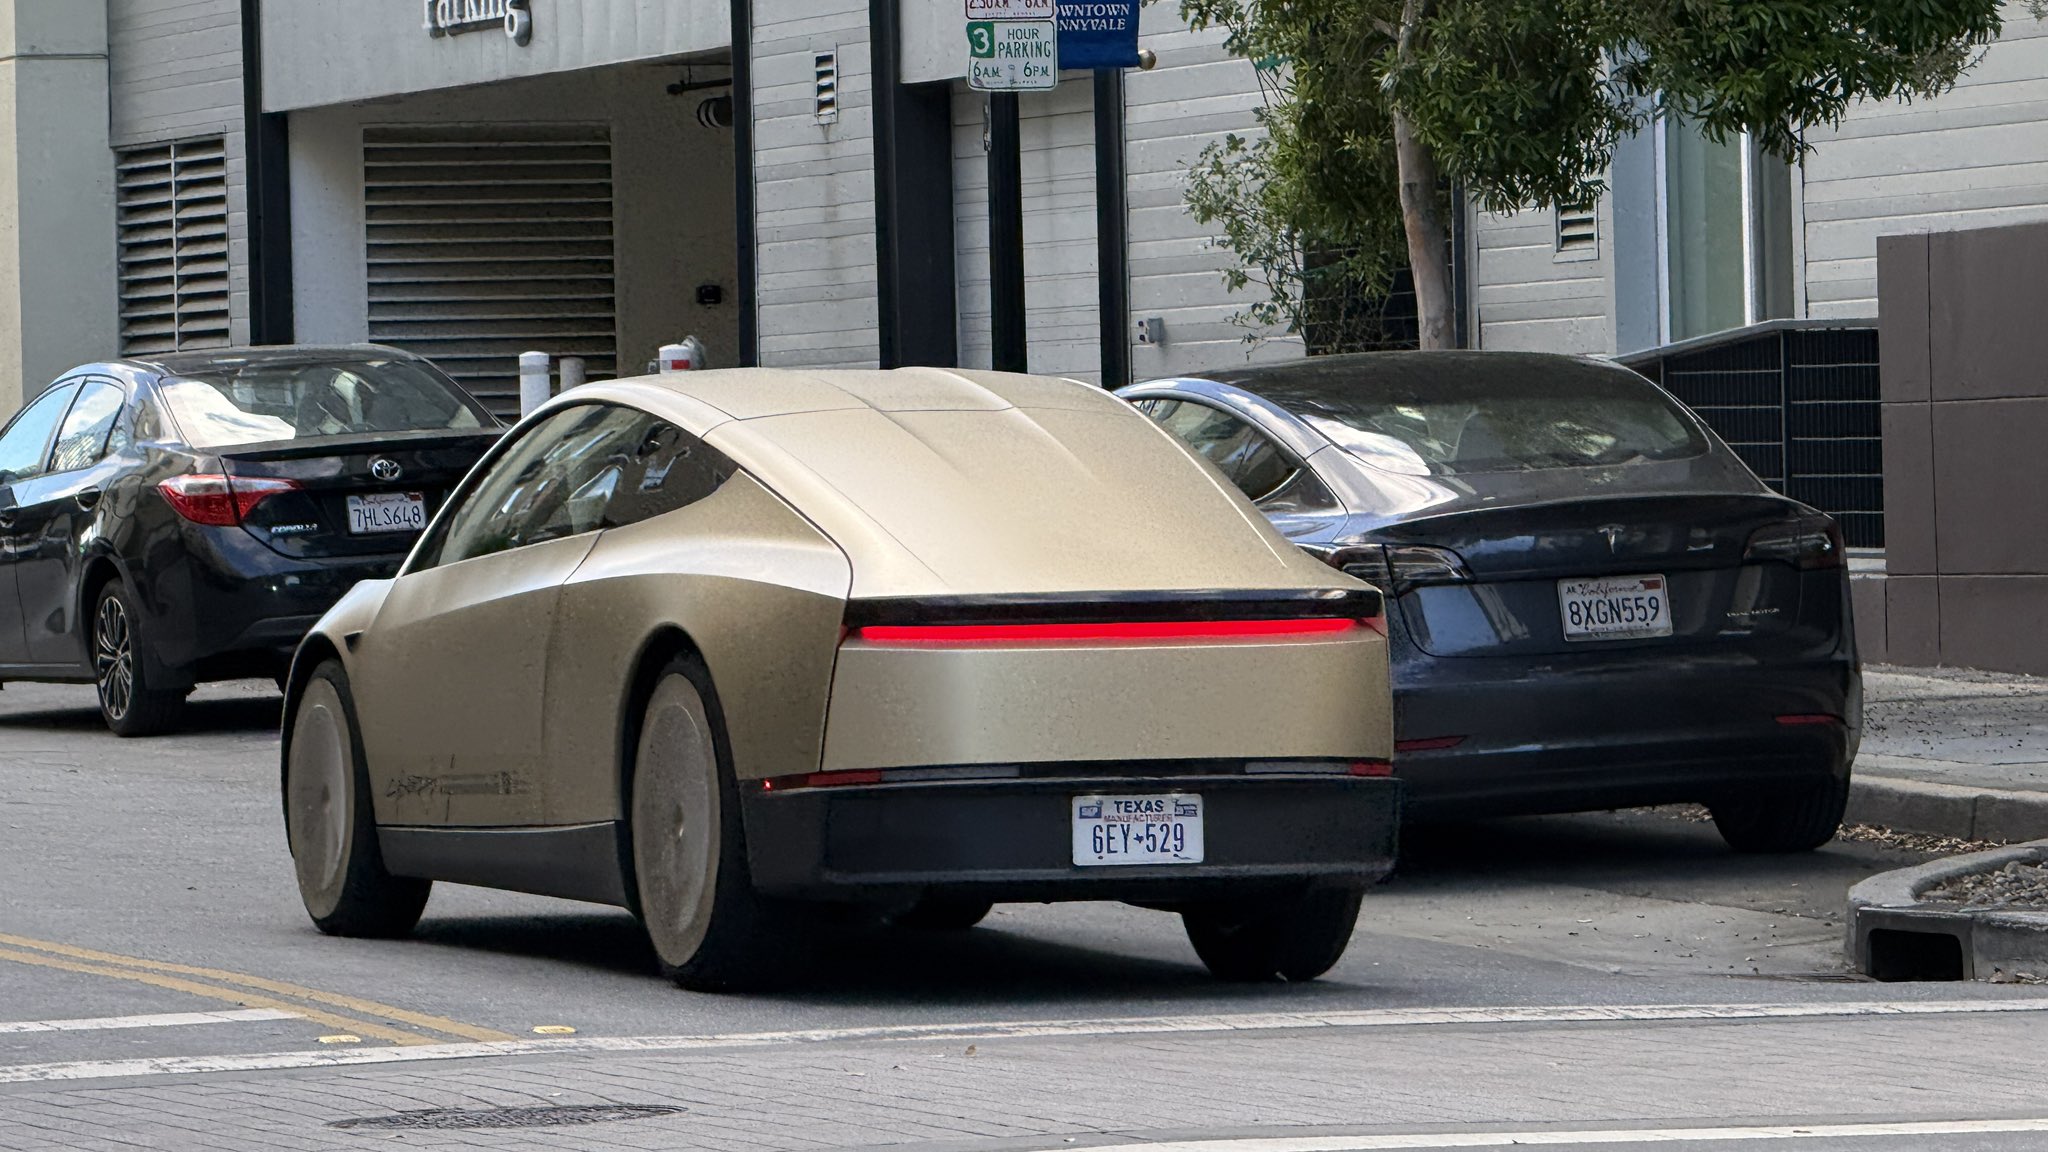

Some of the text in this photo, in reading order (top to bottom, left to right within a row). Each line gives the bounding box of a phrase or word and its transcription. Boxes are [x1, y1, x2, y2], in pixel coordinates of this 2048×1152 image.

[1059, 18, 1126, 31] NNYVALE
[973, 27, 1040, 54] 3 HOUR
[998, 41, 1051, 58] PARKING
[353, 505, 422, 529] 7HLS648
[1568, 596, 1660, 626] 8XGN559
[1114, 799, 1164, 813] TEXAS
